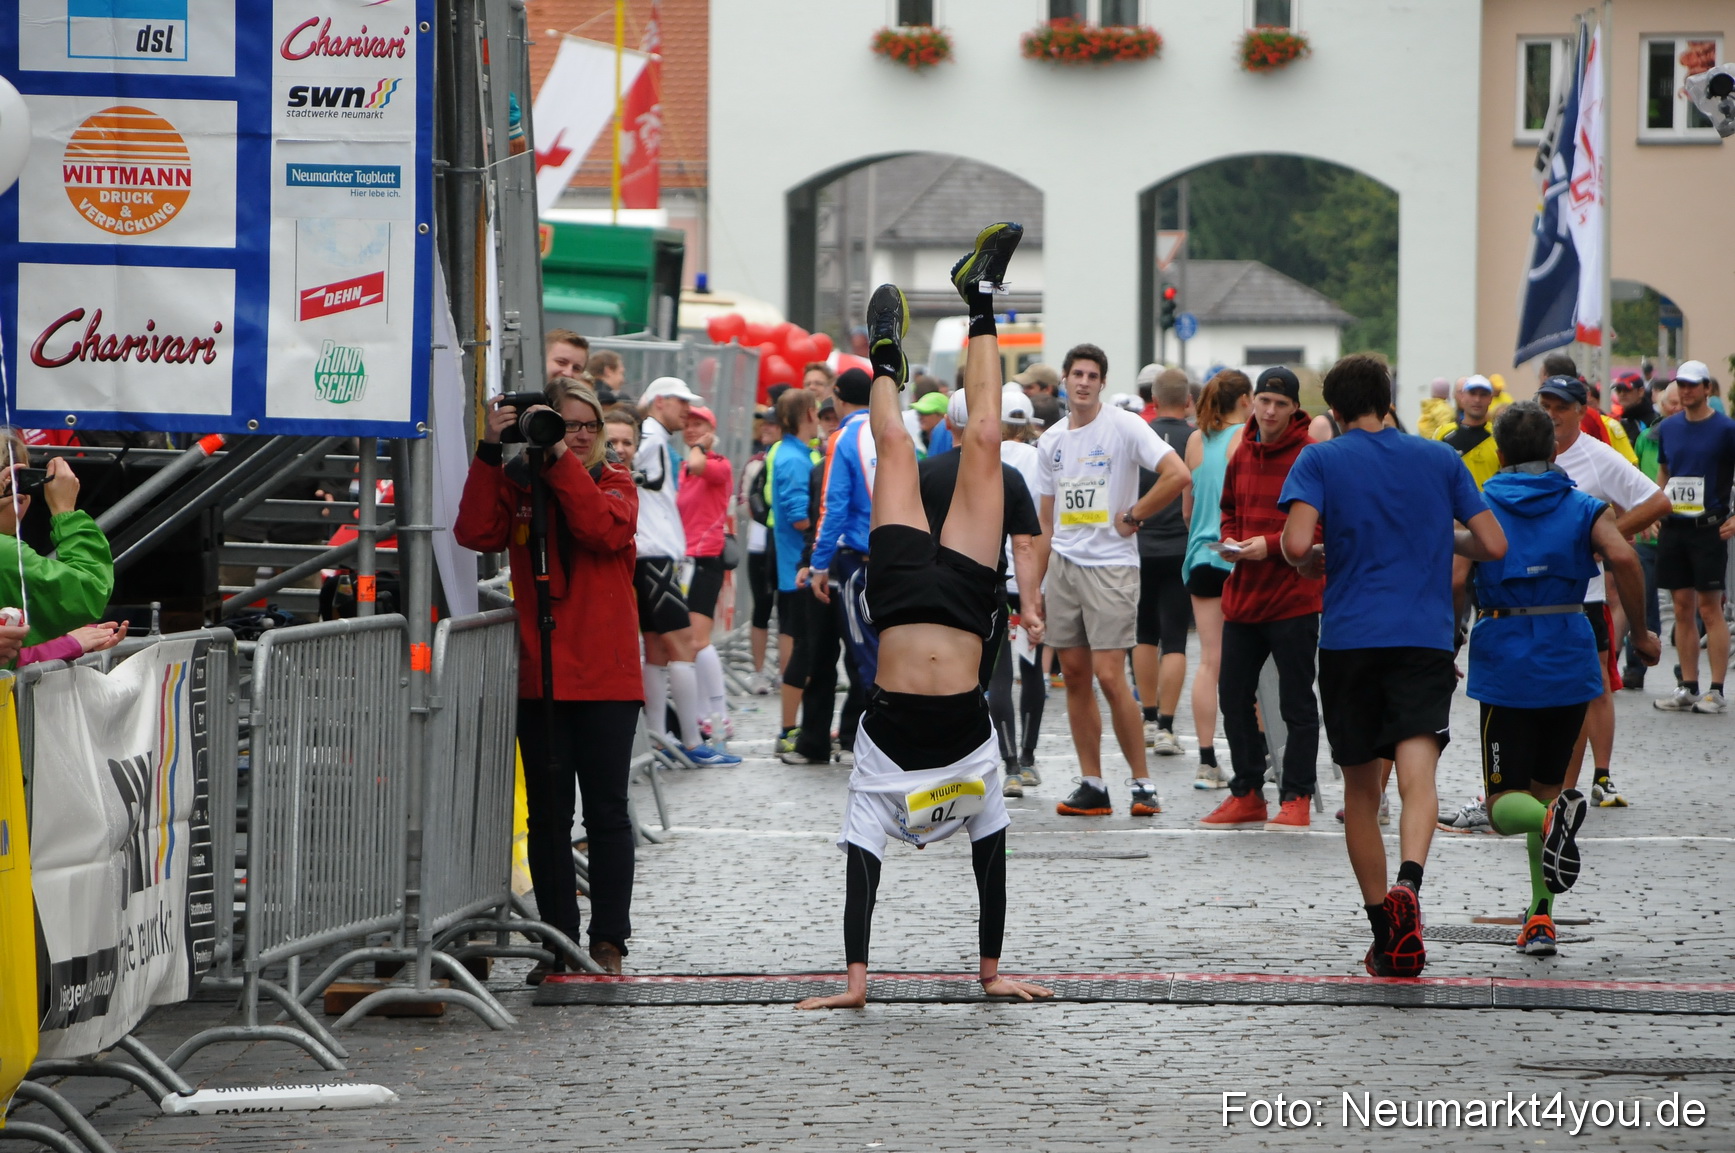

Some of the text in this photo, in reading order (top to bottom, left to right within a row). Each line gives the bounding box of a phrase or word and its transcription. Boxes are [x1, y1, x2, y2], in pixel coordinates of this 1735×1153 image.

[136, 24, 174, 53] dsl
[280, 16, 410, 61] Charivari
[287, 85, 365, 108] swn
[286, 109, 384, 119] stadtwerke neumarkt
[63, 165, 192, 187] WITTMANN
[291, 168, 396, 184] Neumarkter Tagblatt
[99, 190, 154, 205] DRUCK
[350, 189, 401, 198] Hier lebe ich.
[78, 197, 176, 233] VERPACKUNG
[120, 205, 132, 218] &
[323, 285, 363, 308] DEHN
[30, 307, 223, 369] Charivari
[316, 339, 364, 374] RUND
[314, 374, 369, 402] SCHAU
[1065, 488, 1096, 510] 567
[1672, 487, 1695, 501] 179
[930, 784, 961, 801] Jannik
